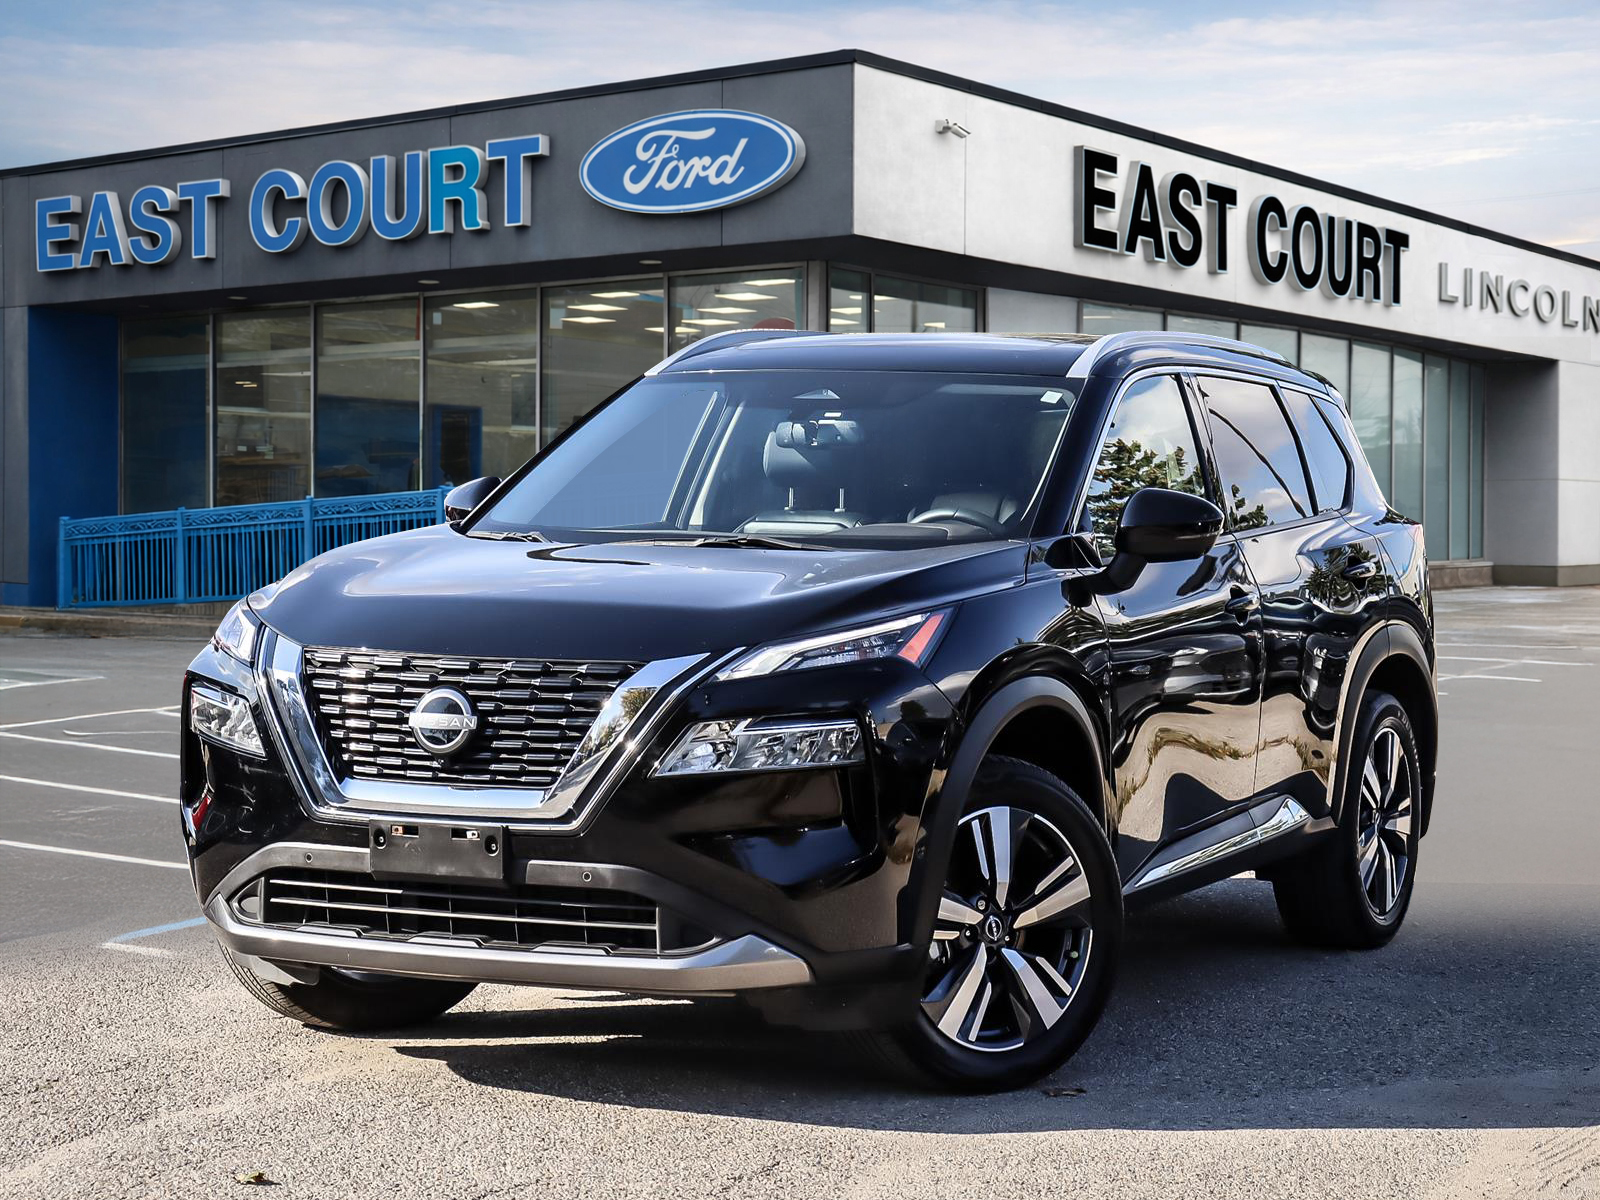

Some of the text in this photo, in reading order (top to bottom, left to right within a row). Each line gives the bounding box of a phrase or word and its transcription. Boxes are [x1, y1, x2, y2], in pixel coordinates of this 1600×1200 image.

[36, 134, 549, 272] EAST COURT
[623, 127, 749, 195] Ford
[1074, 145, 1600, 334] EAST COURT LINCOLN
[411, 714, 475, 728] SSAN
